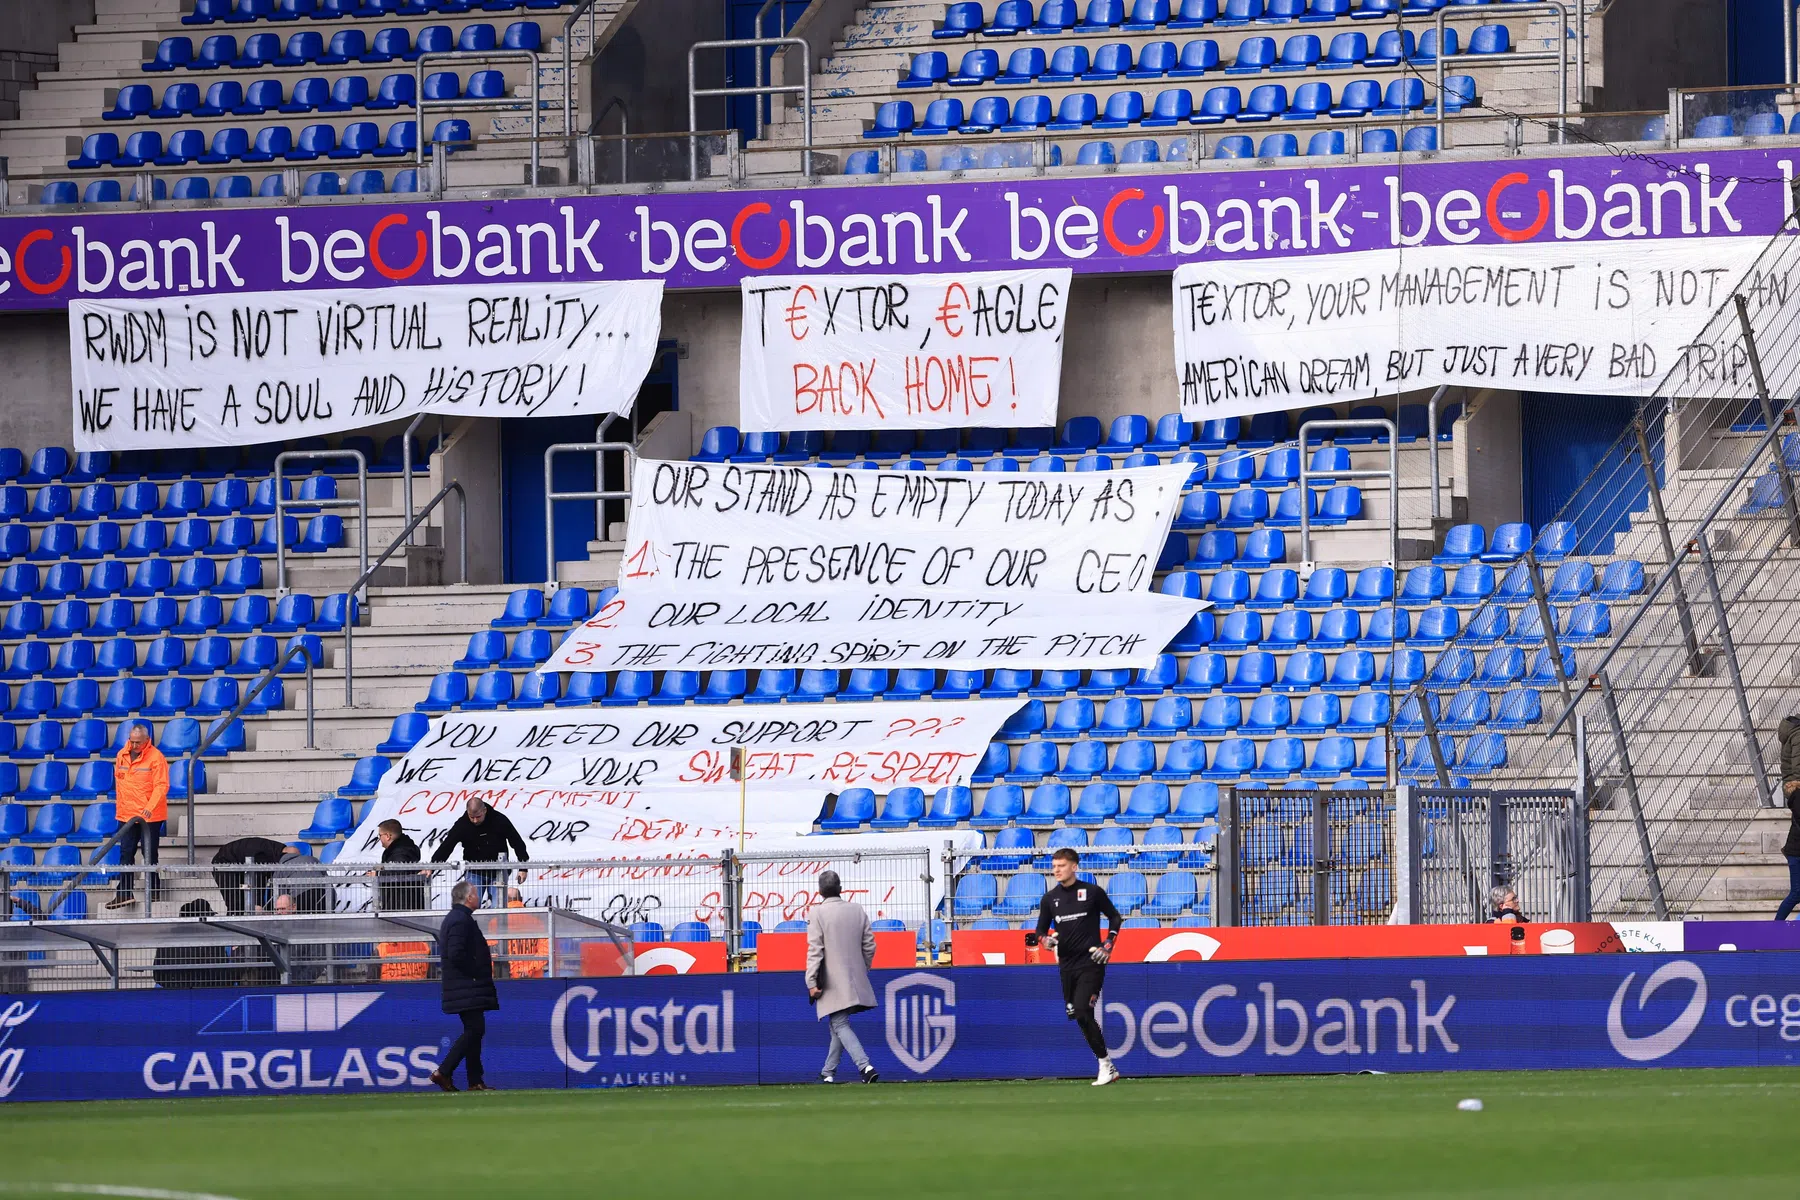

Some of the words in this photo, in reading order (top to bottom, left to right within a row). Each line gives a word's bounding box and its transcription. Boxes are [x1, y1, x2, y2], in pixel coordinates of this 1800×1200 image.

[1307, 277, 1371, 324] YOUR
[1380, 265, 1575, 311] MANAGEMENT
[1651, 268, 1729, 308] NOT
[1748, 271, 1788, 308] AN
[83, 308, 168, 367] RWDM
[232, 306, 298, 360] NOT
[1386, 349, 1435, 381] BUT
[1443, 346, 1508, 377] JUST
[1608, 343, 1657, 379] BAD
[79, 388, 120, 433] WE
[133, 388, 203, 432] HAVE
[221, 385, 242, 427] A
[254, 378, 333, 424] SOUL
[351, 373, 406, 416] AND
[793, 359, 885, 419] BACK
[653, 463, 710, 509] OUR
[715, 468, 812, 518] STAND
[819, 471, 856, 520] AS
[872, 475, 986, 527] EMPTY
[999, 480, 1084, 526] TODAY
[1090, 478, 1135, 522] AS
[626, 540, 655, 578] 1.
[672, 541, 730, 580] THE
[741, 543, 916, 585] PRESENCE
[922, 546, 974, 586] OF
[985, 548, 1048, 588] OUR
[1076, 549, 1148, 593] CEO
[649, 601, 721, 629] OUR
[724, 600, 829, 625] LOCAL
[611, 643, 680, 666] THE
[923, 640, 966, 659] ON
[978, 634, 1037, 657] THE
[426, 721, 498, 749] YOU
[516, 723, 620, 749] NEED
[631, 721, 699, 747] OUR
[711, 719, 873, 745] SUPPORT
[395, 758, 456, 785] WE
[462, 756, 552, 785] NEED
[570, 757, 658, 786] YOUR
[529, 819, 590, 843] OUR
[601, 894, 662, 924] OUR
[551, 985, 737, 1074] Cristal
[612, 1073, 675, 1085] ALKEN
